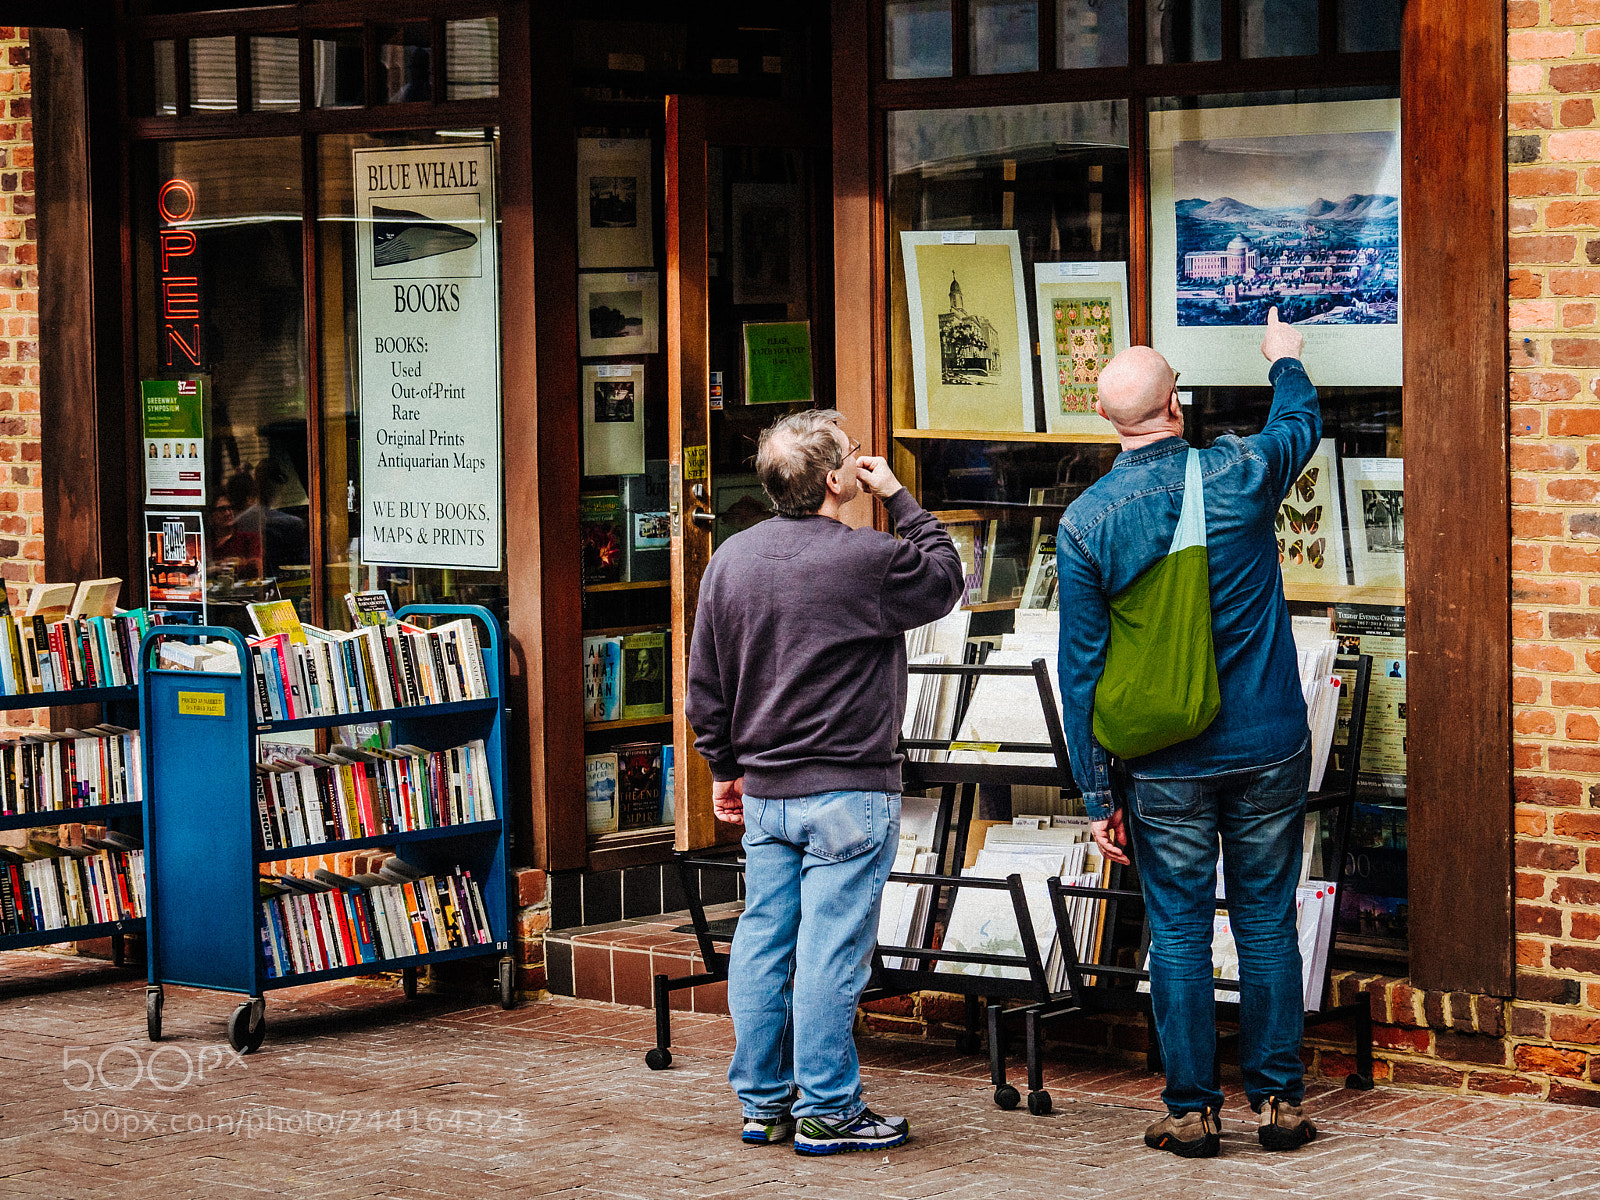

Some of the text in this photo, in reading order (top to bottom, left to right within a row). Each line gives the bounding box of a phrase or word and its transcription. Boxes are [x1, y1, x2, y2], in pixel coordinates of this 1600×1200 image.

[367, 160, 479, 191] BLUE WHALE
[158, 178, 201, 366] OPEN
[393, 283, 460, 313] BOOKS
[375, 336, 429, 354] BOOKS:
[391, 361, 422, 378] Used
[391, 382, 466, 400] Out-of-Print
[147, 397, 178, 405] GREENWAY
[147, 404, 180, 412] SYMPOSIUM
[392, 404, 421, 421] Rare
[376, 428, 465, 449] Original Prints
[377, 451, 486, 473] Antiquarian Maps
[373, 501, 490, 524] WE BUY BOOKS,
[373, 525, 485, 547] MAPS & PRINTS
[1359, 613, 1380, 621] EVENING
[588, 643, 611, 659] ALL
[82, 640, 97, 682] CORRECTIONS
[585, 662, 614, 679] THAT
[258, 678, 269, 713] POWERS
[586, 682, 612, 698] MAN
[593, 702, 606, 718] IS
[261, 813, 273, 847] HOUR
